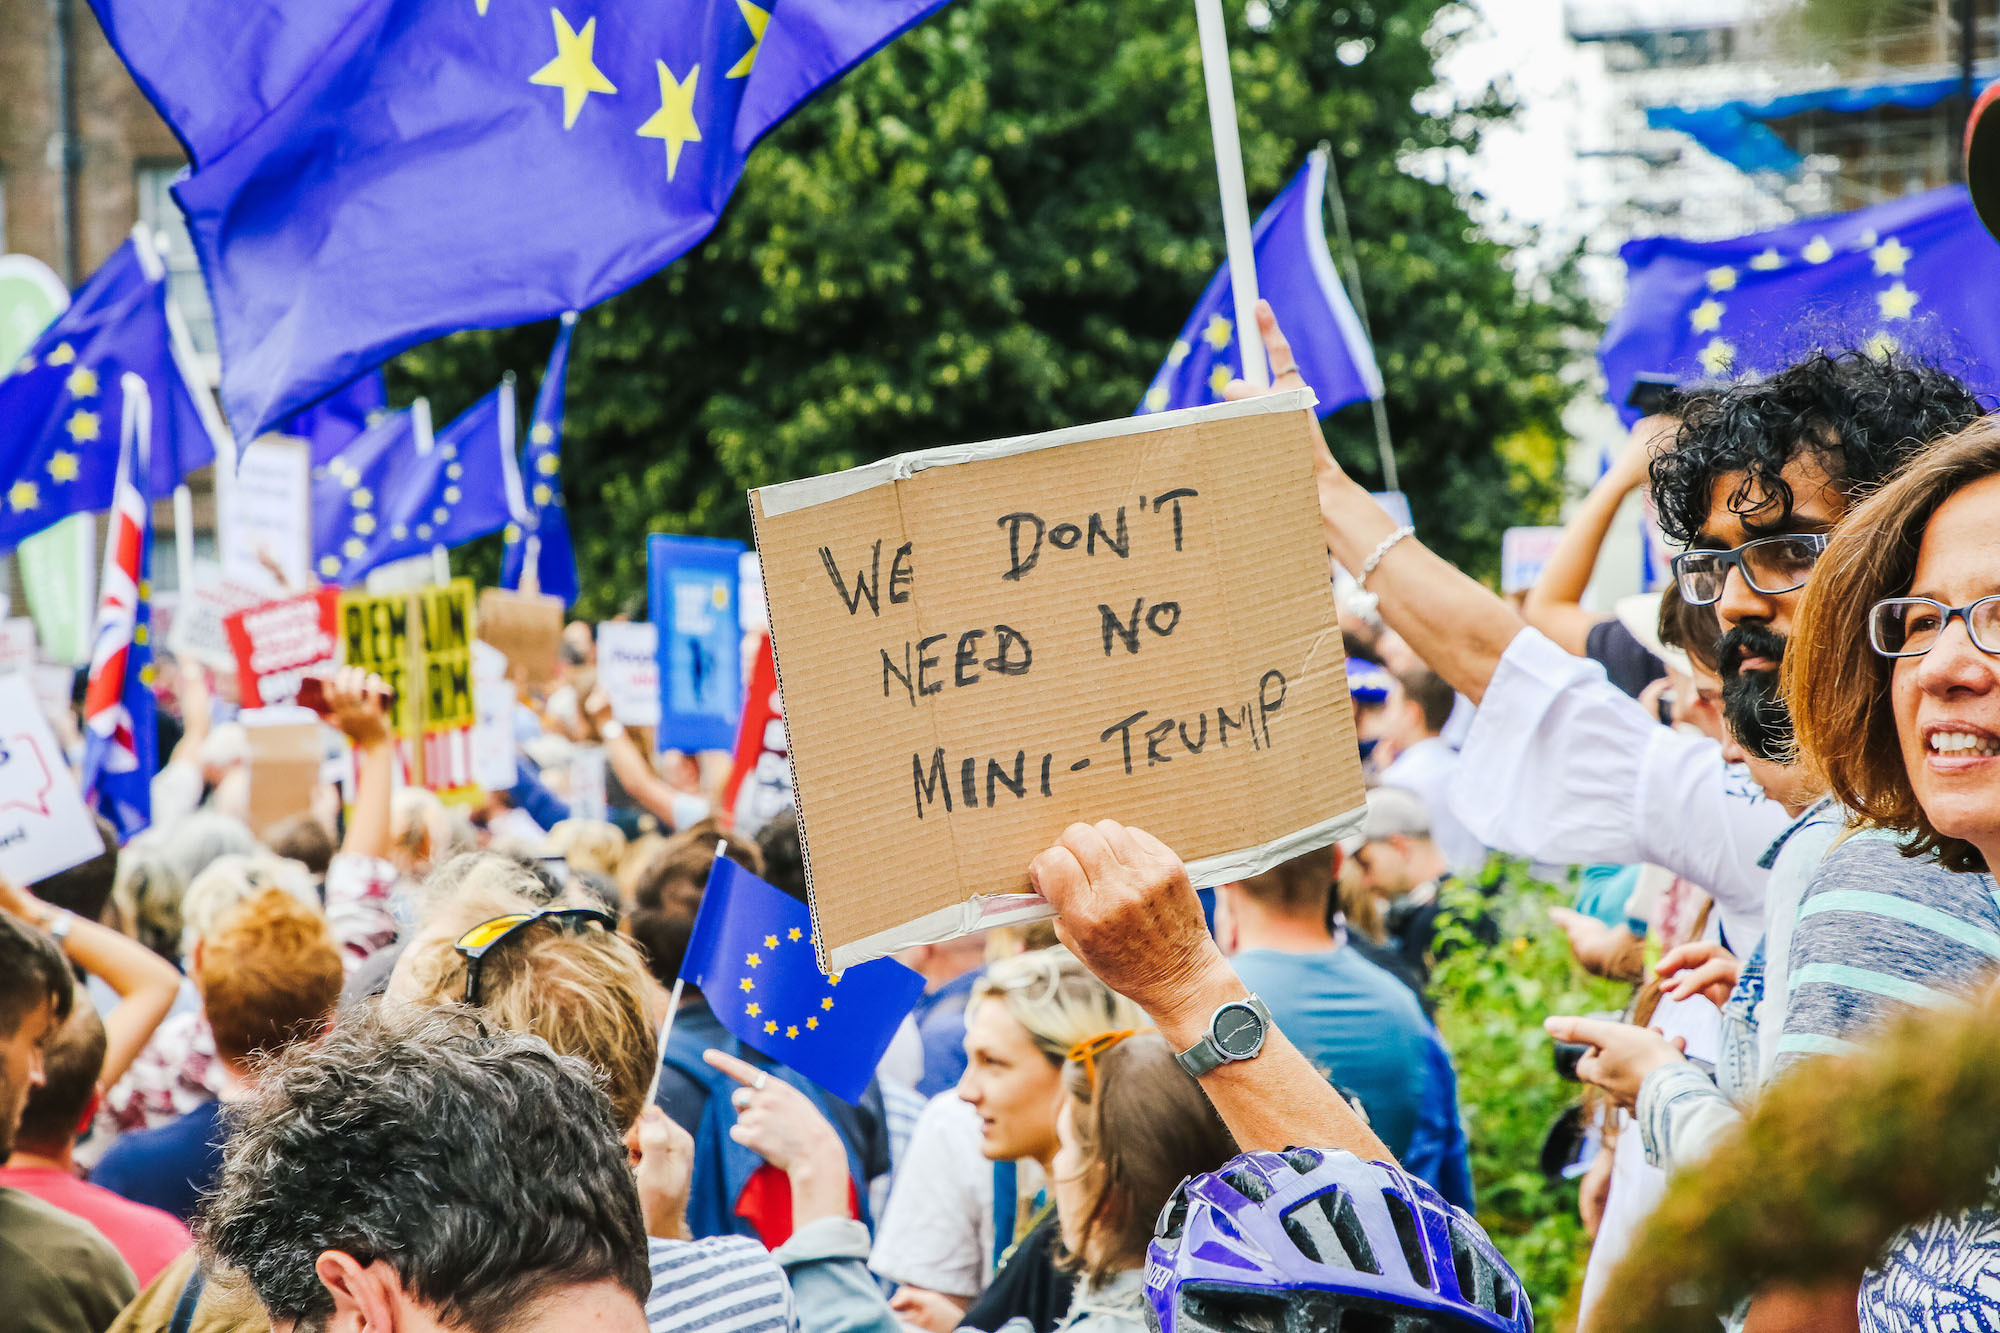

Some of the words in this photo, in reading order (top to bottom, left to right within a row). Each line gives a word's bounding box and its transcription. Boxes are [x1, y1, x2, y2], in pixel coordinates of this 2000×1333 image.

[818, 539, 914, 616] WE
[998, 488, 1198, 581] DON'T
[880, 625, 1033, 706] NEED
[1097, 597, 1181, 656] NO
[912, 669, 1287, 819] MINI-TRUMP
